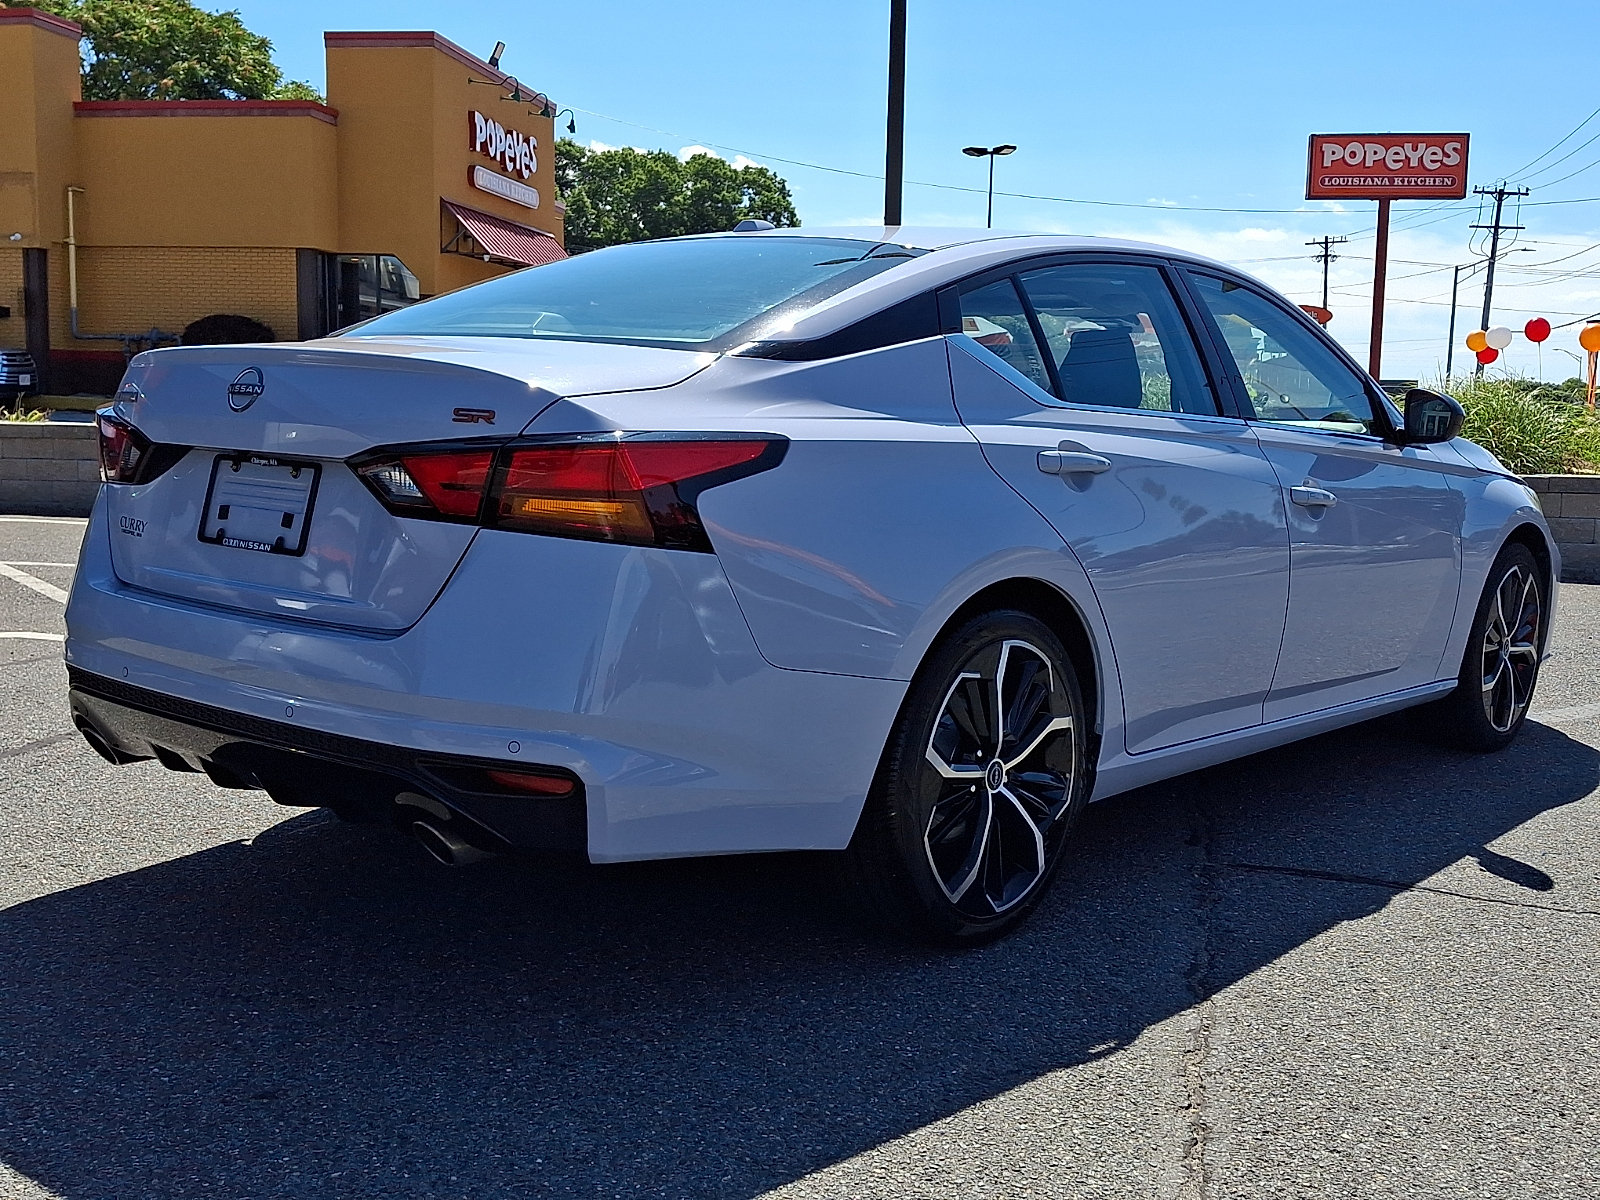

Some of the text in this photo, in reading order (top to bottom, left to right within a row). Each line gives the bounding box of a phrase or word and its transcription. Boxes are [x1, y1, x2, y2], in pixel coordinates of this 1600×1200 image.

[1324, 177, 1453, 186] LOUISIANA KITCHEN
[229, 384, 262, 393] NISSAN
[452, 408, 495, 425] SR
[120, 515, 148, 532] CURRY
